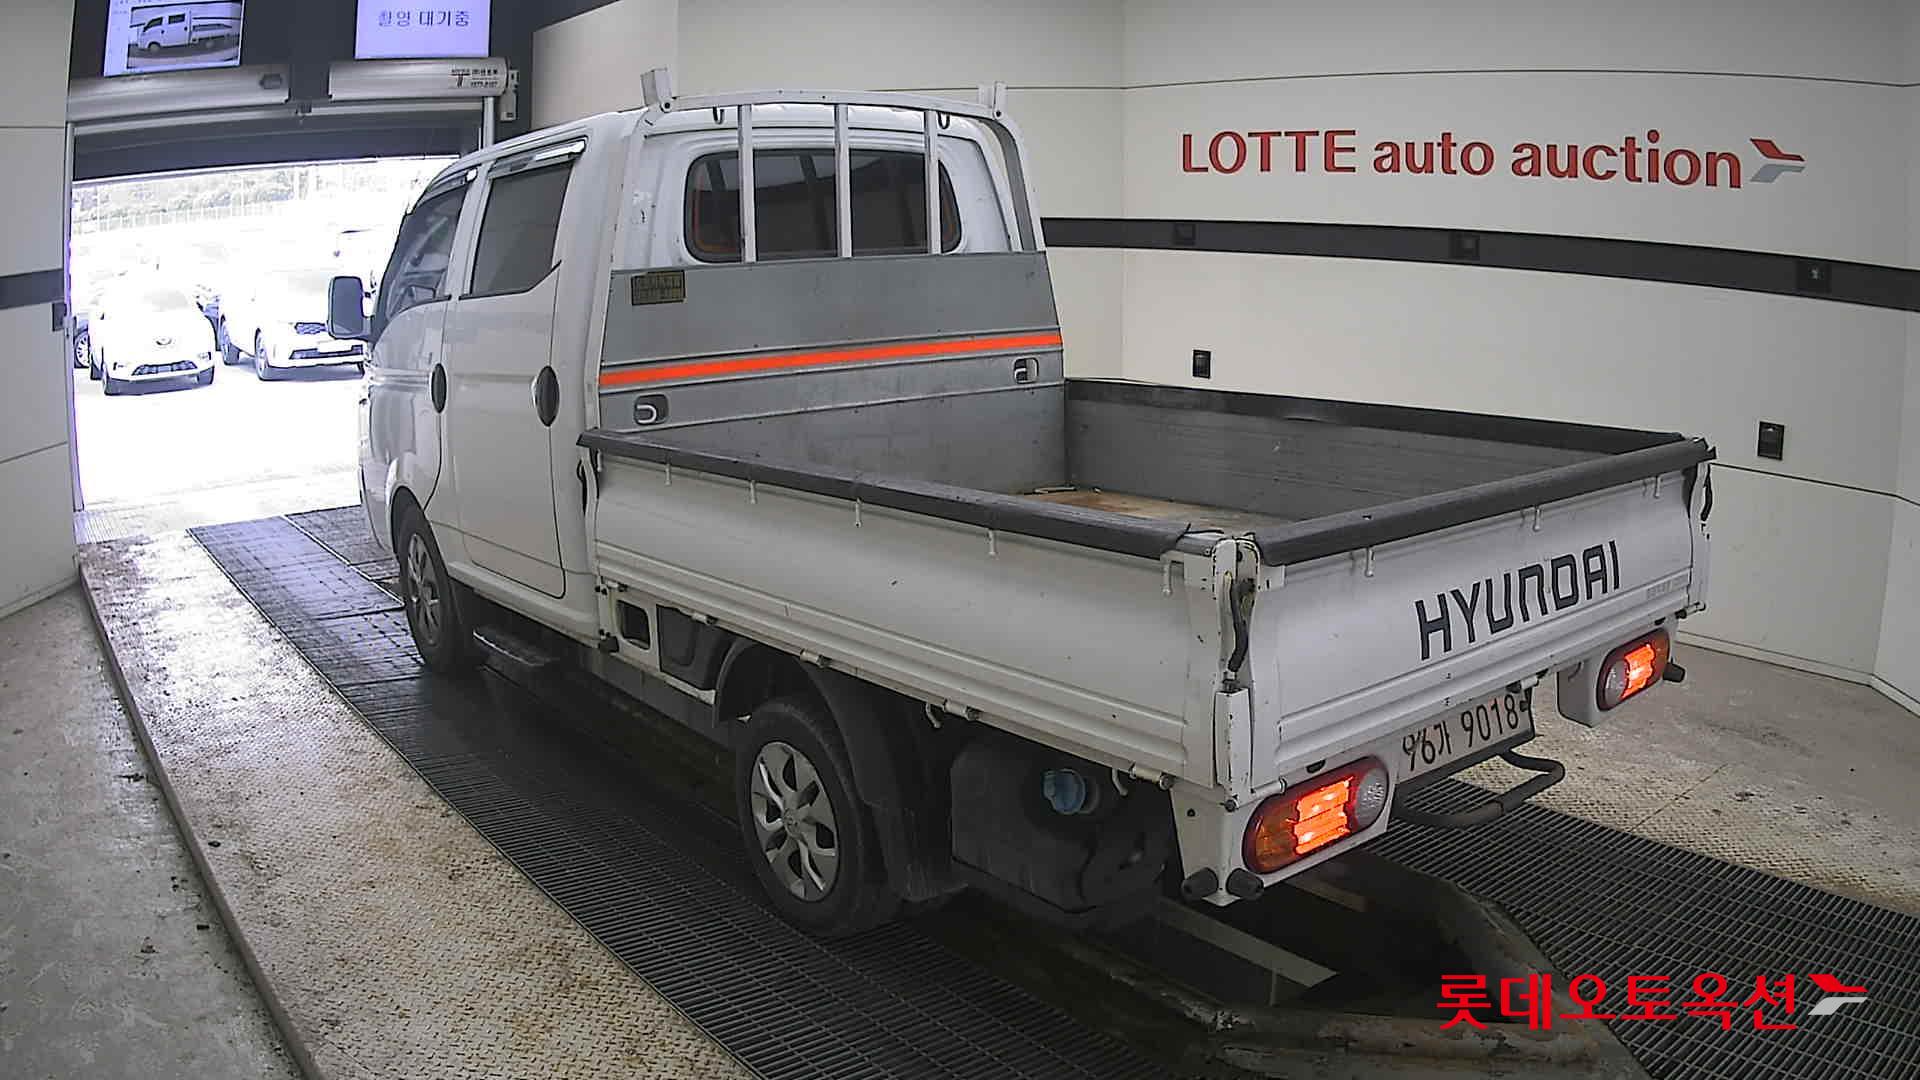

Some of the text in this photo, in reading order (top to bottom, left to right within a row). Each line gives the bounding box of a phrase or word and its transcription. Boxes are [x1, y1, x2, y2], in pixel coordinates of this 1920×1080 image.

[418, 10, 469, 27] 대기중
[1181, 129, 1742, 188] LOTTE auto auction
[1415, 540, 1620, 660] HYUNDAI
[1461, 694, 1518, 748] 9018
